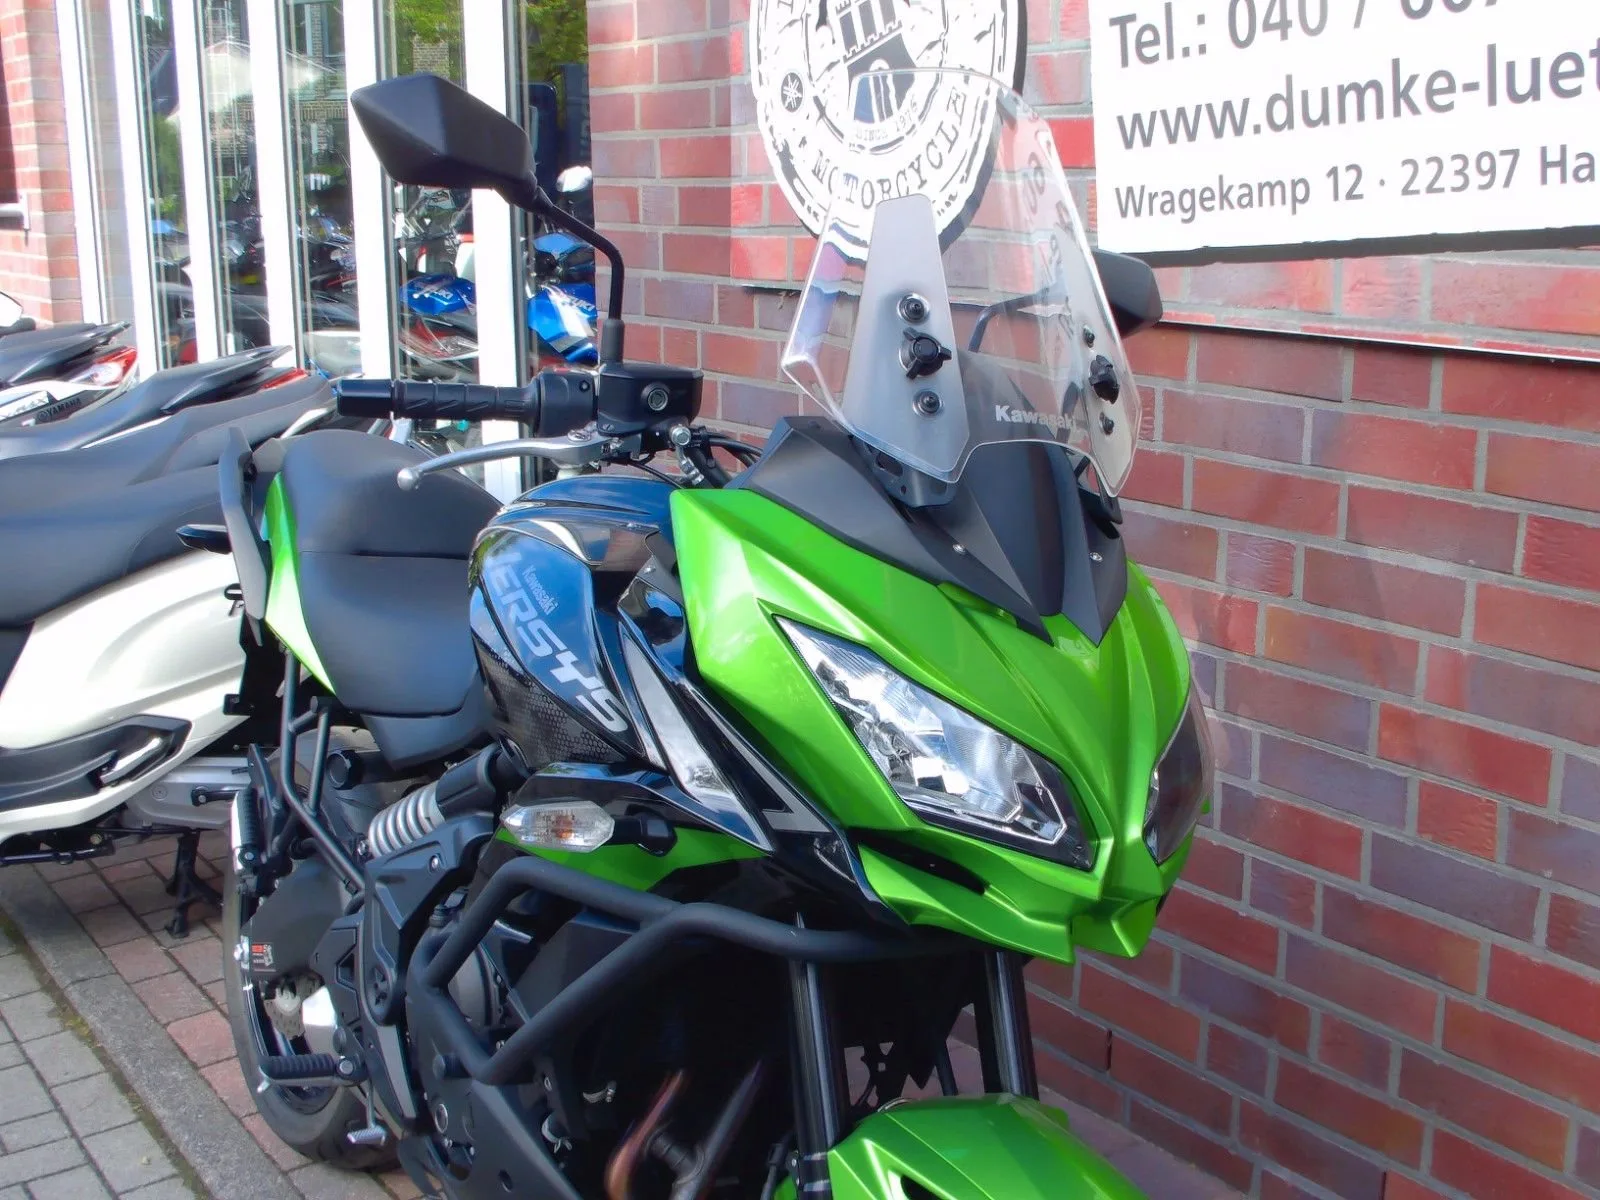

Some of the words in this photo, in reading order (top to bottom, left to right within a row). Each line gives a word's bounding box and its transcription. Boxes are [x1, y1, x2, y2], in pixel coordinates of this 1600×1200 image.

[1108, 1, 1207, 69] Tel.:
[1227, 0, 1328, 50] 040
[1114, 174, 1311, 225] Wragekamp
[1325, 163, 1365, 202] 12
[1400, 148, 1521, 197] 22397
[1539, 143, 1597, 186] Ha
[994, 404, 1077, 430] Kawasaki
[522, 565, 559, 616] Kawasaki
